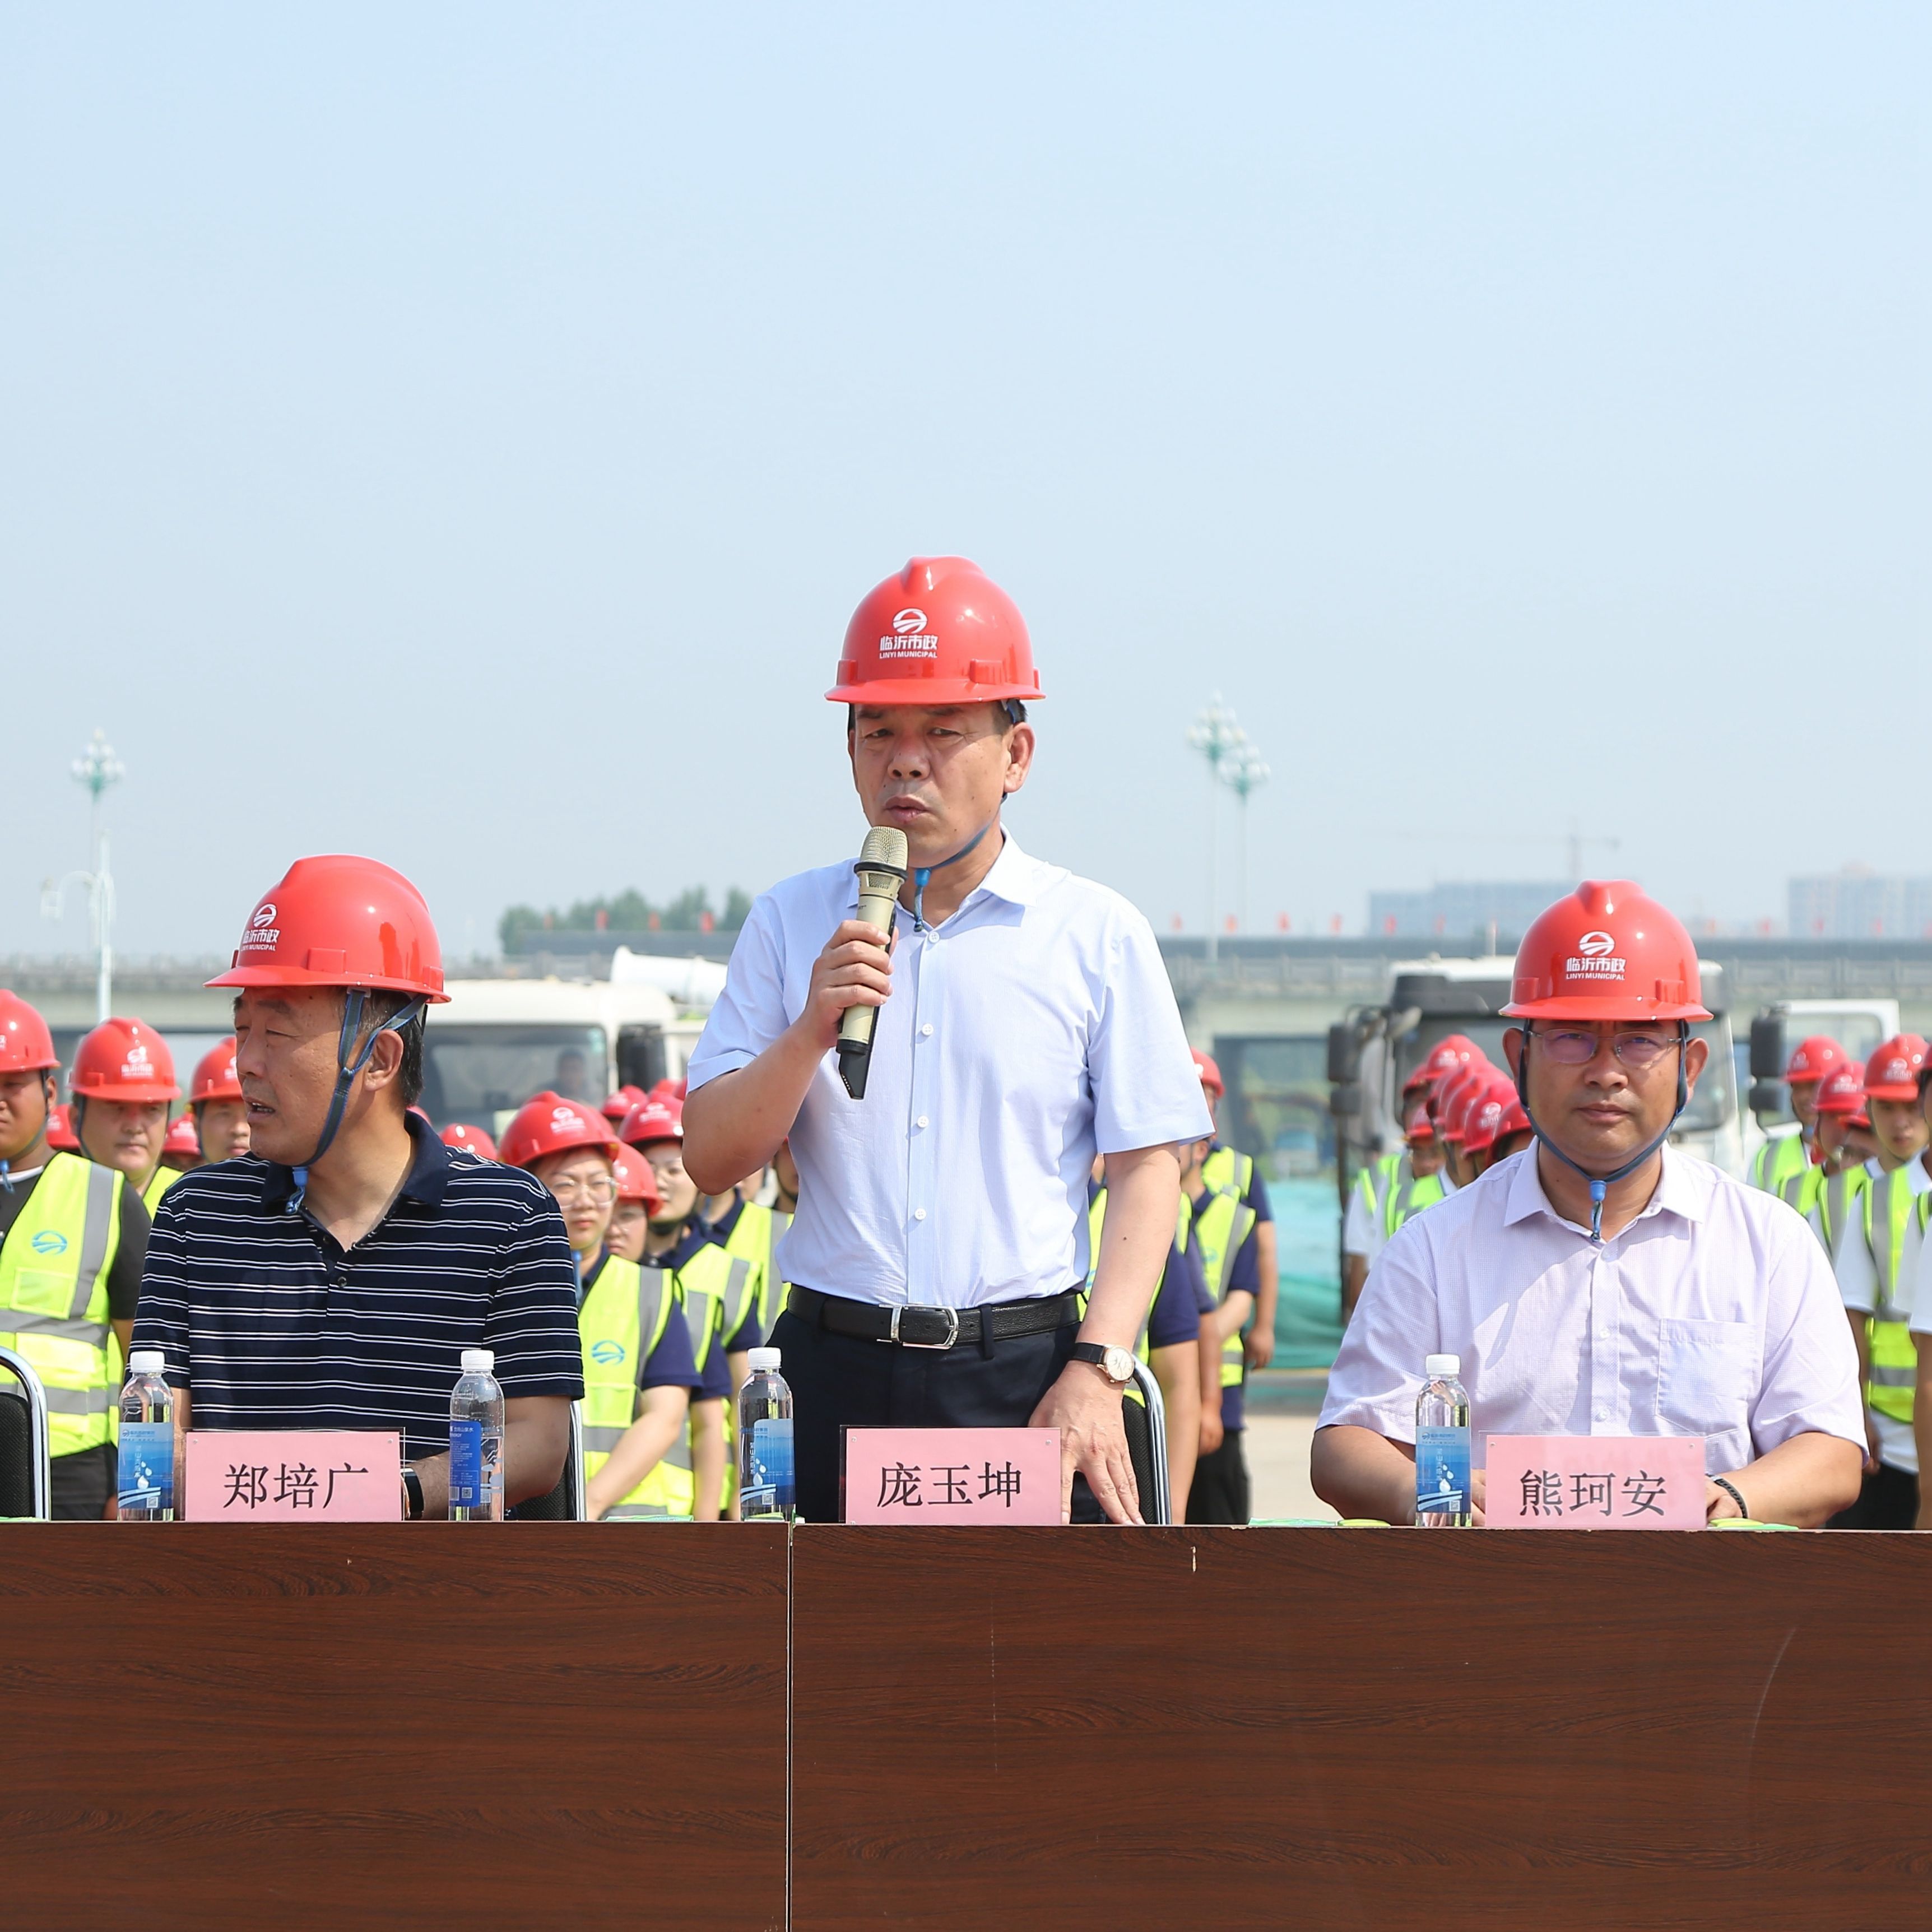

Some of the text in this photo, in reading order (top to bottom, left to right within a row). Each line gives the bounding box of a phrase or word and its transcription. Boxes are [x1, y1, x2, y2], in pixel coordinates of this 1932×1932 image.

[880, 634, 939, 651] 临沂市政
[1566, 957, 1627, 972] 临沂市政
[223, 1462, 369, 1509] 郑培广
[877, 1461, 1021, 1508] 庞玉坤
[1519, 1469, 1667, 1517] 熊珂安
